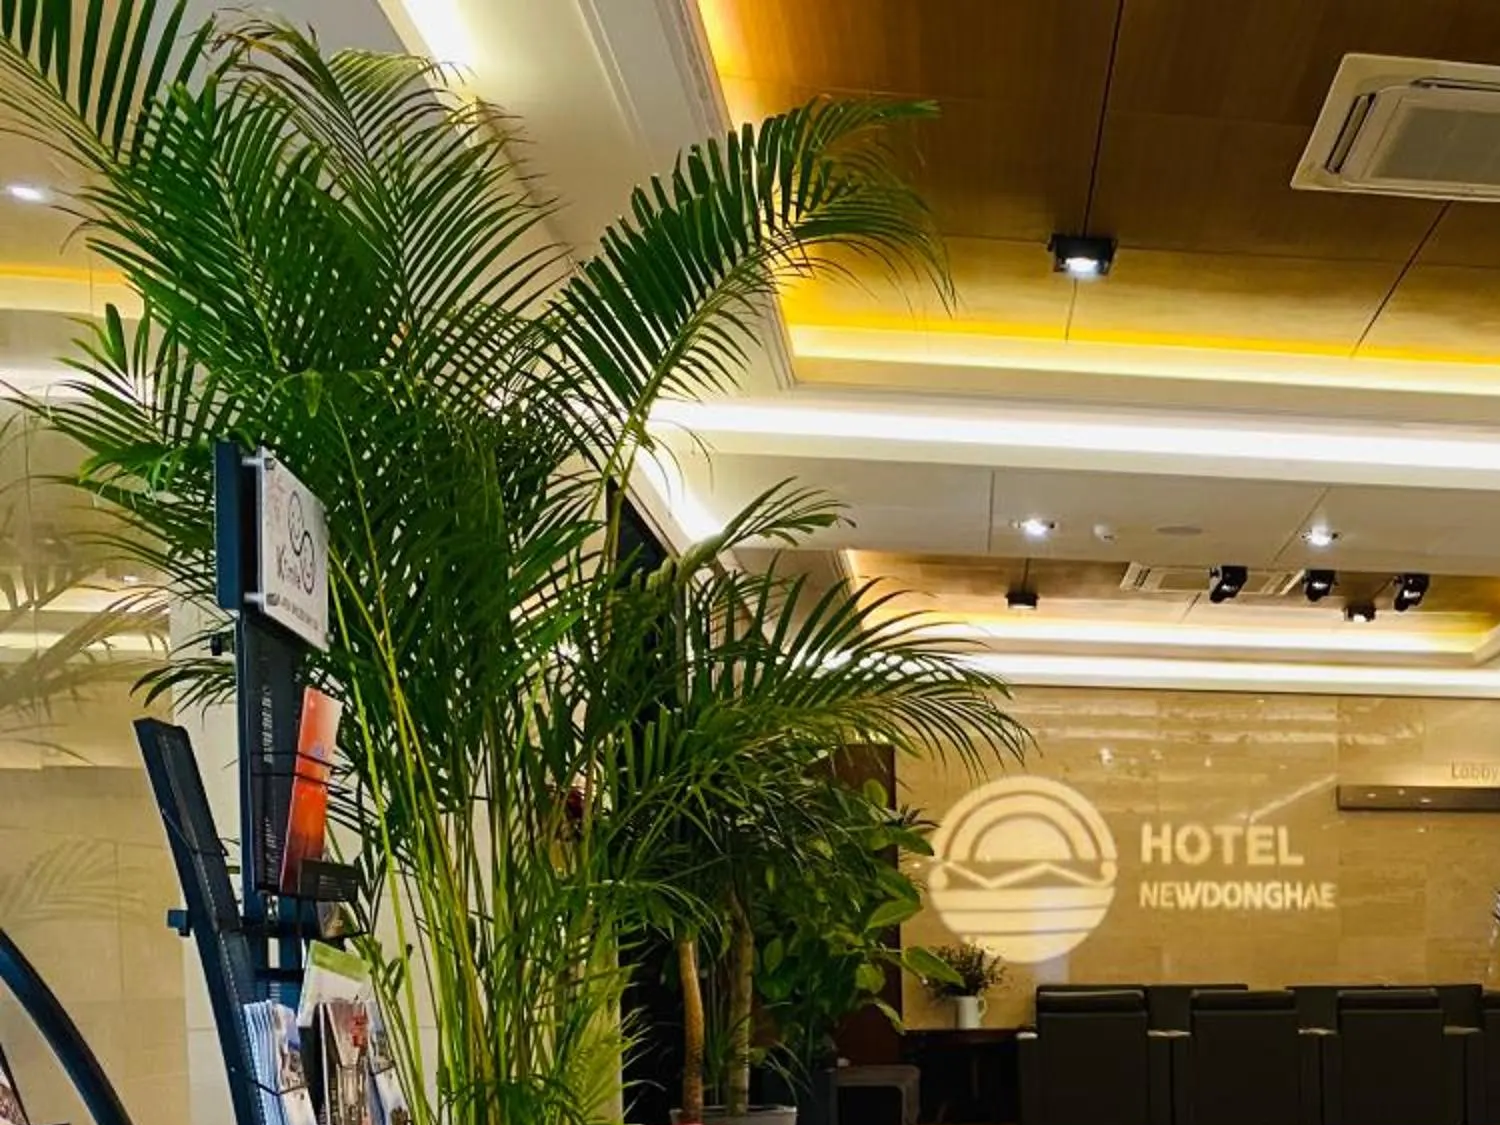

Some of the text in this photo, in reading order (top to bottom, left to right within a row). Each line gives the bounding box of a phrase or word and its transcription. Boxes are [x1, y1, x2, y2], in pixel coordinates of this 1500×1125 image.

[1450, 761, 1498, 783] Lobby
[1140, 822, 1304, 865] HOTEL
[1139, 880, 1337, 910] NEWDONGHAE
